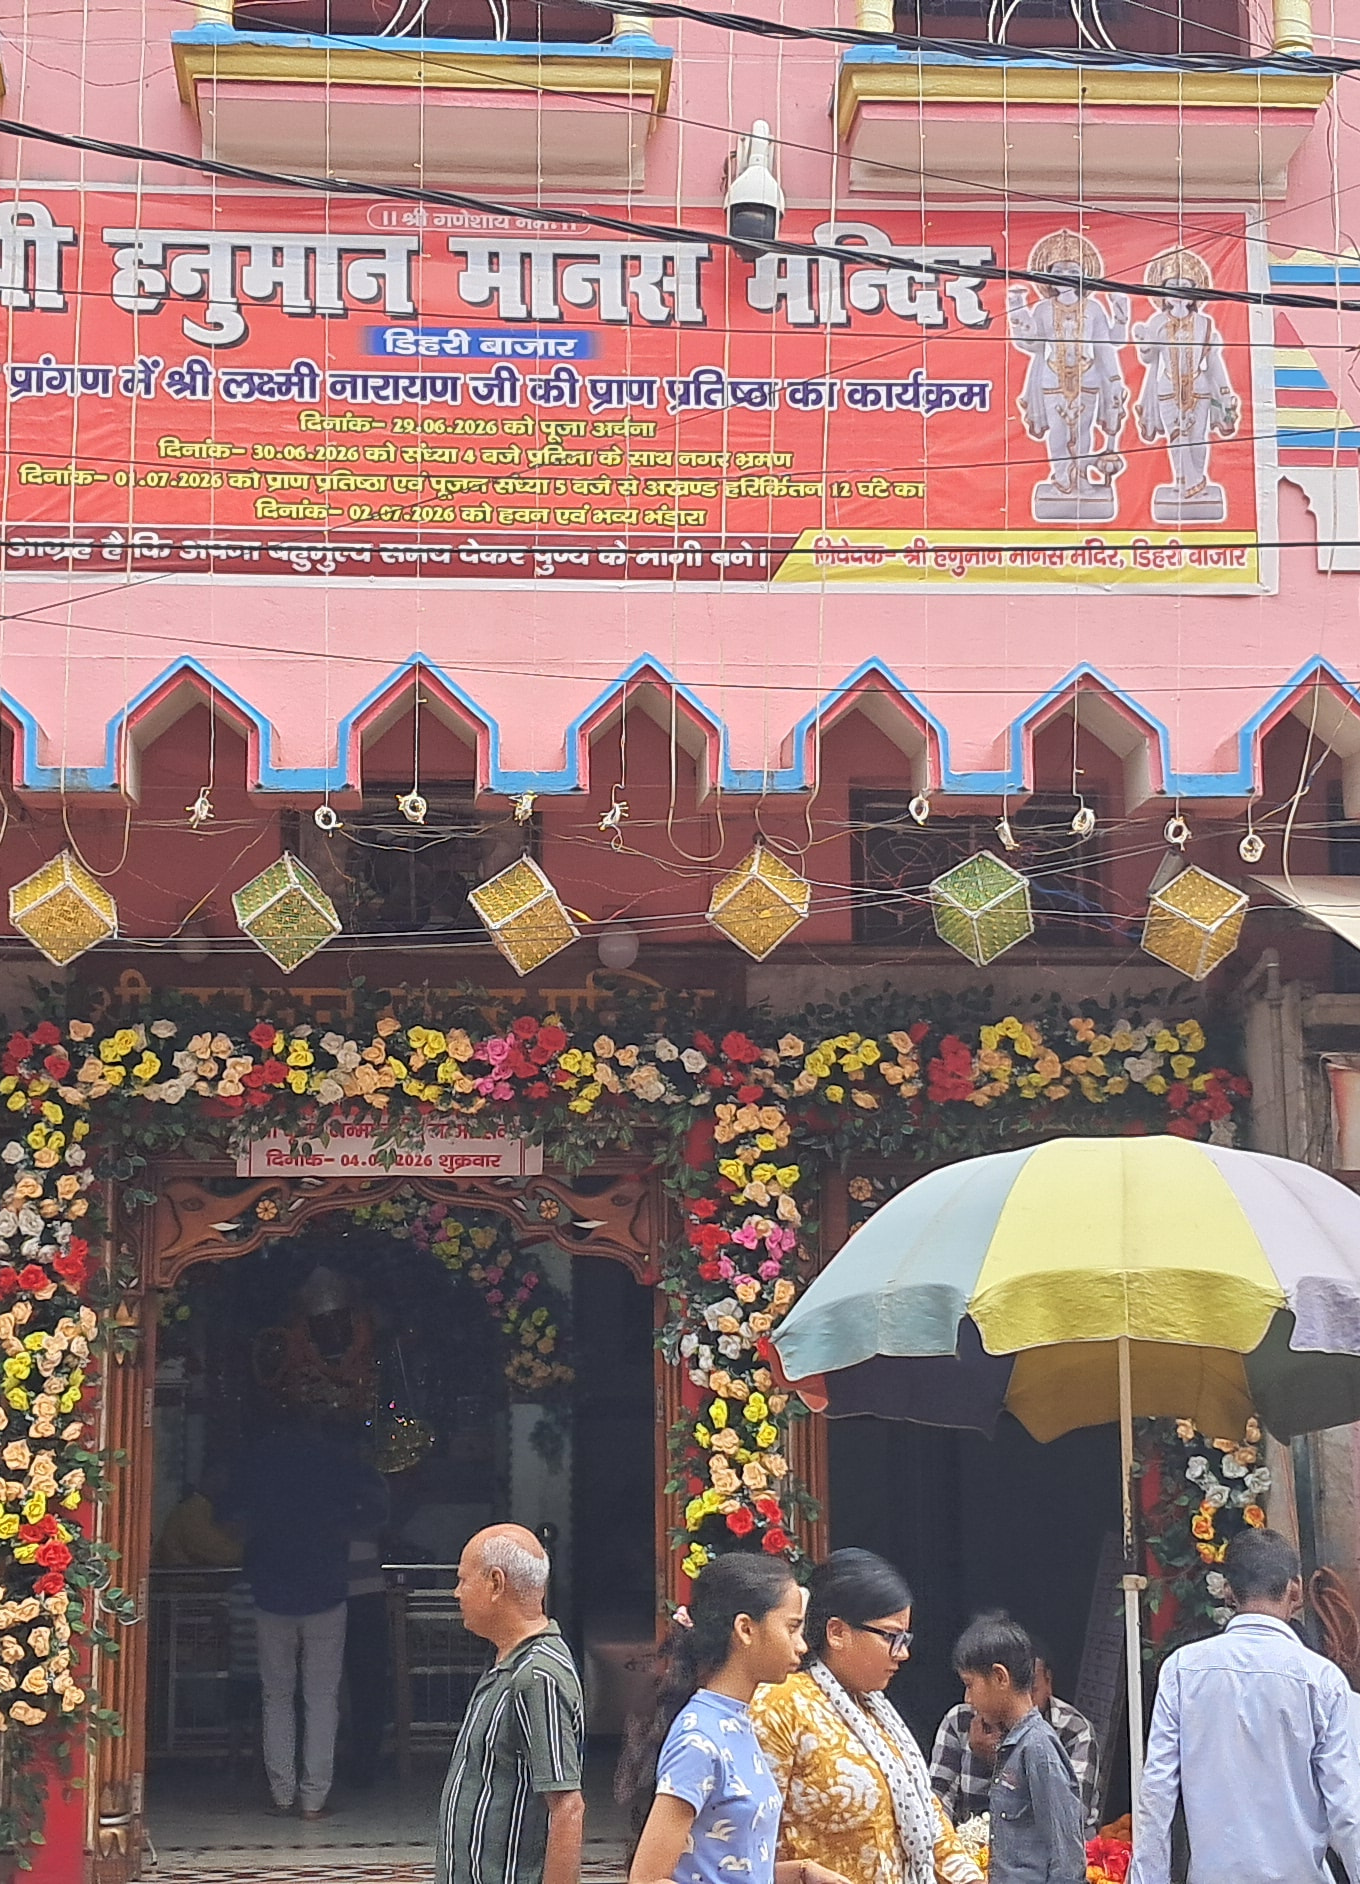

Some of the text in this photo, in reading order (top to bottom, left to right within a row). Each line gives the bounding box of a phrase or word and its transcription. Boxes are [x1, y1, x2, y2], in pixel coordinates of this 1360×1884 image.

[402, 208, 428, 227] श्री
[433, 209, 509, 229] गणेशाय
[103, 228, 420, 347] हनुमान
[449, 236, 711, 324] मानस
[747, 220, 997, 329] मन्दिर
[383, 327, 575, 358] डिहरी बाजार
[6, 354, 112, 401] प्रांगण
[121, 357, 158, 398] में
[165, 356, 212, 399] श्री
[220, 359, 323, 401] लक्ष्मी
[327, 369, 462, 406] नारायण
[468, 361, 521, 409] जी
[529, 361, 581, 407] की
[587, 373, 656, 415] प्राण
[665, 364, 780, 416] प्रतिष्ठा
[786, 375, 840, 410] का
[844, 369, 991, 415] कार्यक्रम
[392, 418, 497, 436] 29.06.2026
[503, 416, 534, 437] को
[540, 420, 588, 442] पूजा
[591, 418, 656, 438] अर्चना
[251, 443, 359, 462] 30.06.2026
[365, 441, 395, 462] को
[401, 441, 458, 464] संध्या
[462, 447, 476, 465] 4
[482, 445, 523, 467] बजे
[528, 448, 593, 470] प्रतिमा
[599, 448, 624, 467] के
[628, 452, 673, 468] साथ
[678, 452, 729, 469] नगर
[735, 451, 793, 470] भ्रमण
[114, 471, 222, 488] 01.07.2026
[229, 468, 259, 490] को
[265, 472, 309, 493] प्राण
[314, 470, 387, 494] प्रतिष्ठा
[392, 470, 425, 494] एवं
[429, 475, 489, 499] पूजन
[493, 472, 549, 496] संध्या
[554, 480, 568, 497] 5
[572, 476, 613, 497] बजे
[617, 476, 638, 497] से
[644, 479, 718, 499] अखण्ड
[831, 482, 851, 498] 12
[856, 476, 890, 499] घंटे
[894, 480, 926, 499] का
[348, 504, 454, 523] 02.07.2026
[462, 502, 492, 523] को
[498, 508, 549, 525] हवन
[554, 503, 588, 526] एवं
[591, 508, 638, 526] भव्य
[644, 505, 707, 527] भंडारा
[6, 536, 94, 562] आग्रह
[100, 530, 126, 561] है
[131, 531, 174, 560] कि
[380, 543, 453, 566] समय
[456, 538, 529, 566] देकर
[532, 544, 593, 577] पुण्य
[597, 540, 629, 567] के
[903, 536, 929, 568] श्री
[340, 1154, 433, 1168] 04.02026
[438, 1153, 503, 1174] शुक्रवार
